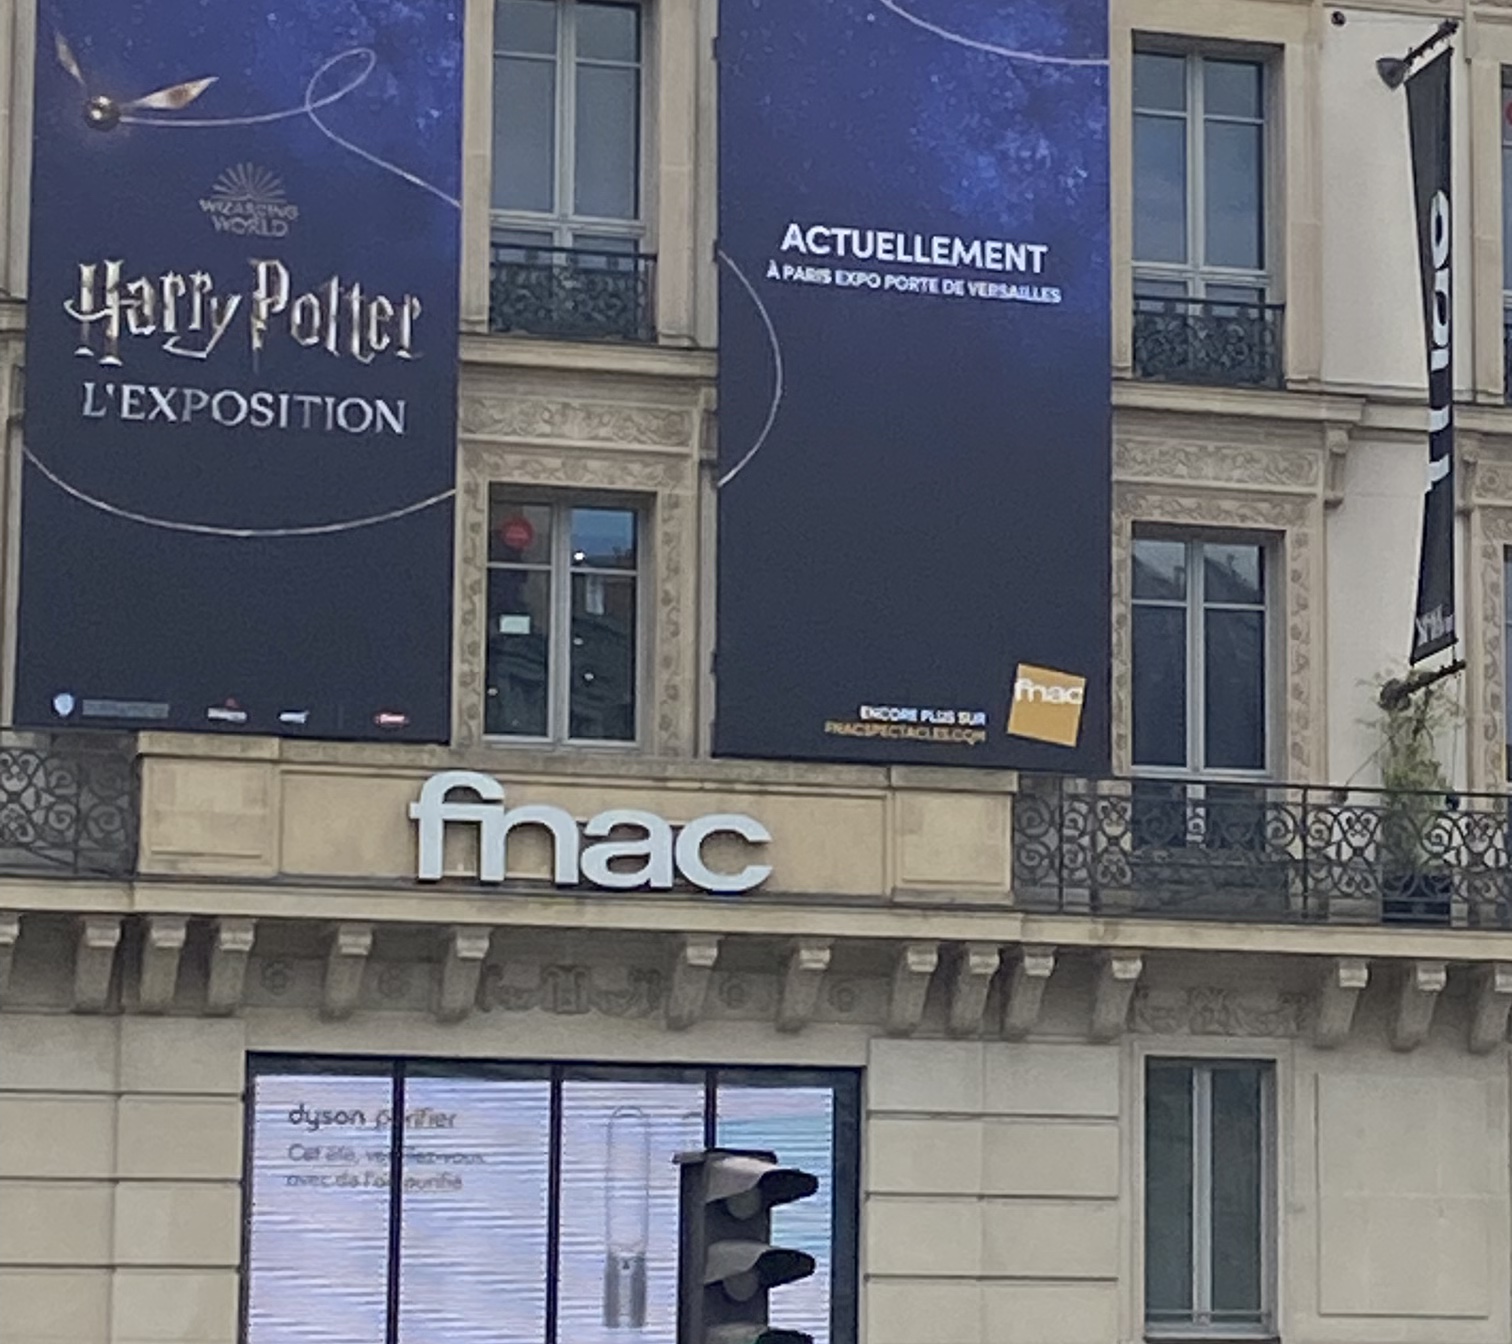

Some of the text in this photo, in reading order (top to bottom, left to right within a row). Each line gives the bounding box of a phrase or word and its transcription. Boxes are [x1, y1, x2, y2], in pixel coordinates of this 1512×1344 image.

[211, 215, 288, 237] WORLD
[780, 223, 1049, 274] ACTUELLEMENT
[766, 259, 1062, 304] À PARIS EXPO PORTE DE VERSAILLES
[64, 258, 424, 368] Harry Potter
[82, 381, 407, 434] L'EXPOSITION
[1014, 677, 1084, 705] fnac
[957, 712, 986, 726] SUR
[408, 770, 773, 892] fnac
[289, 1102, 366, 1132] dyson
